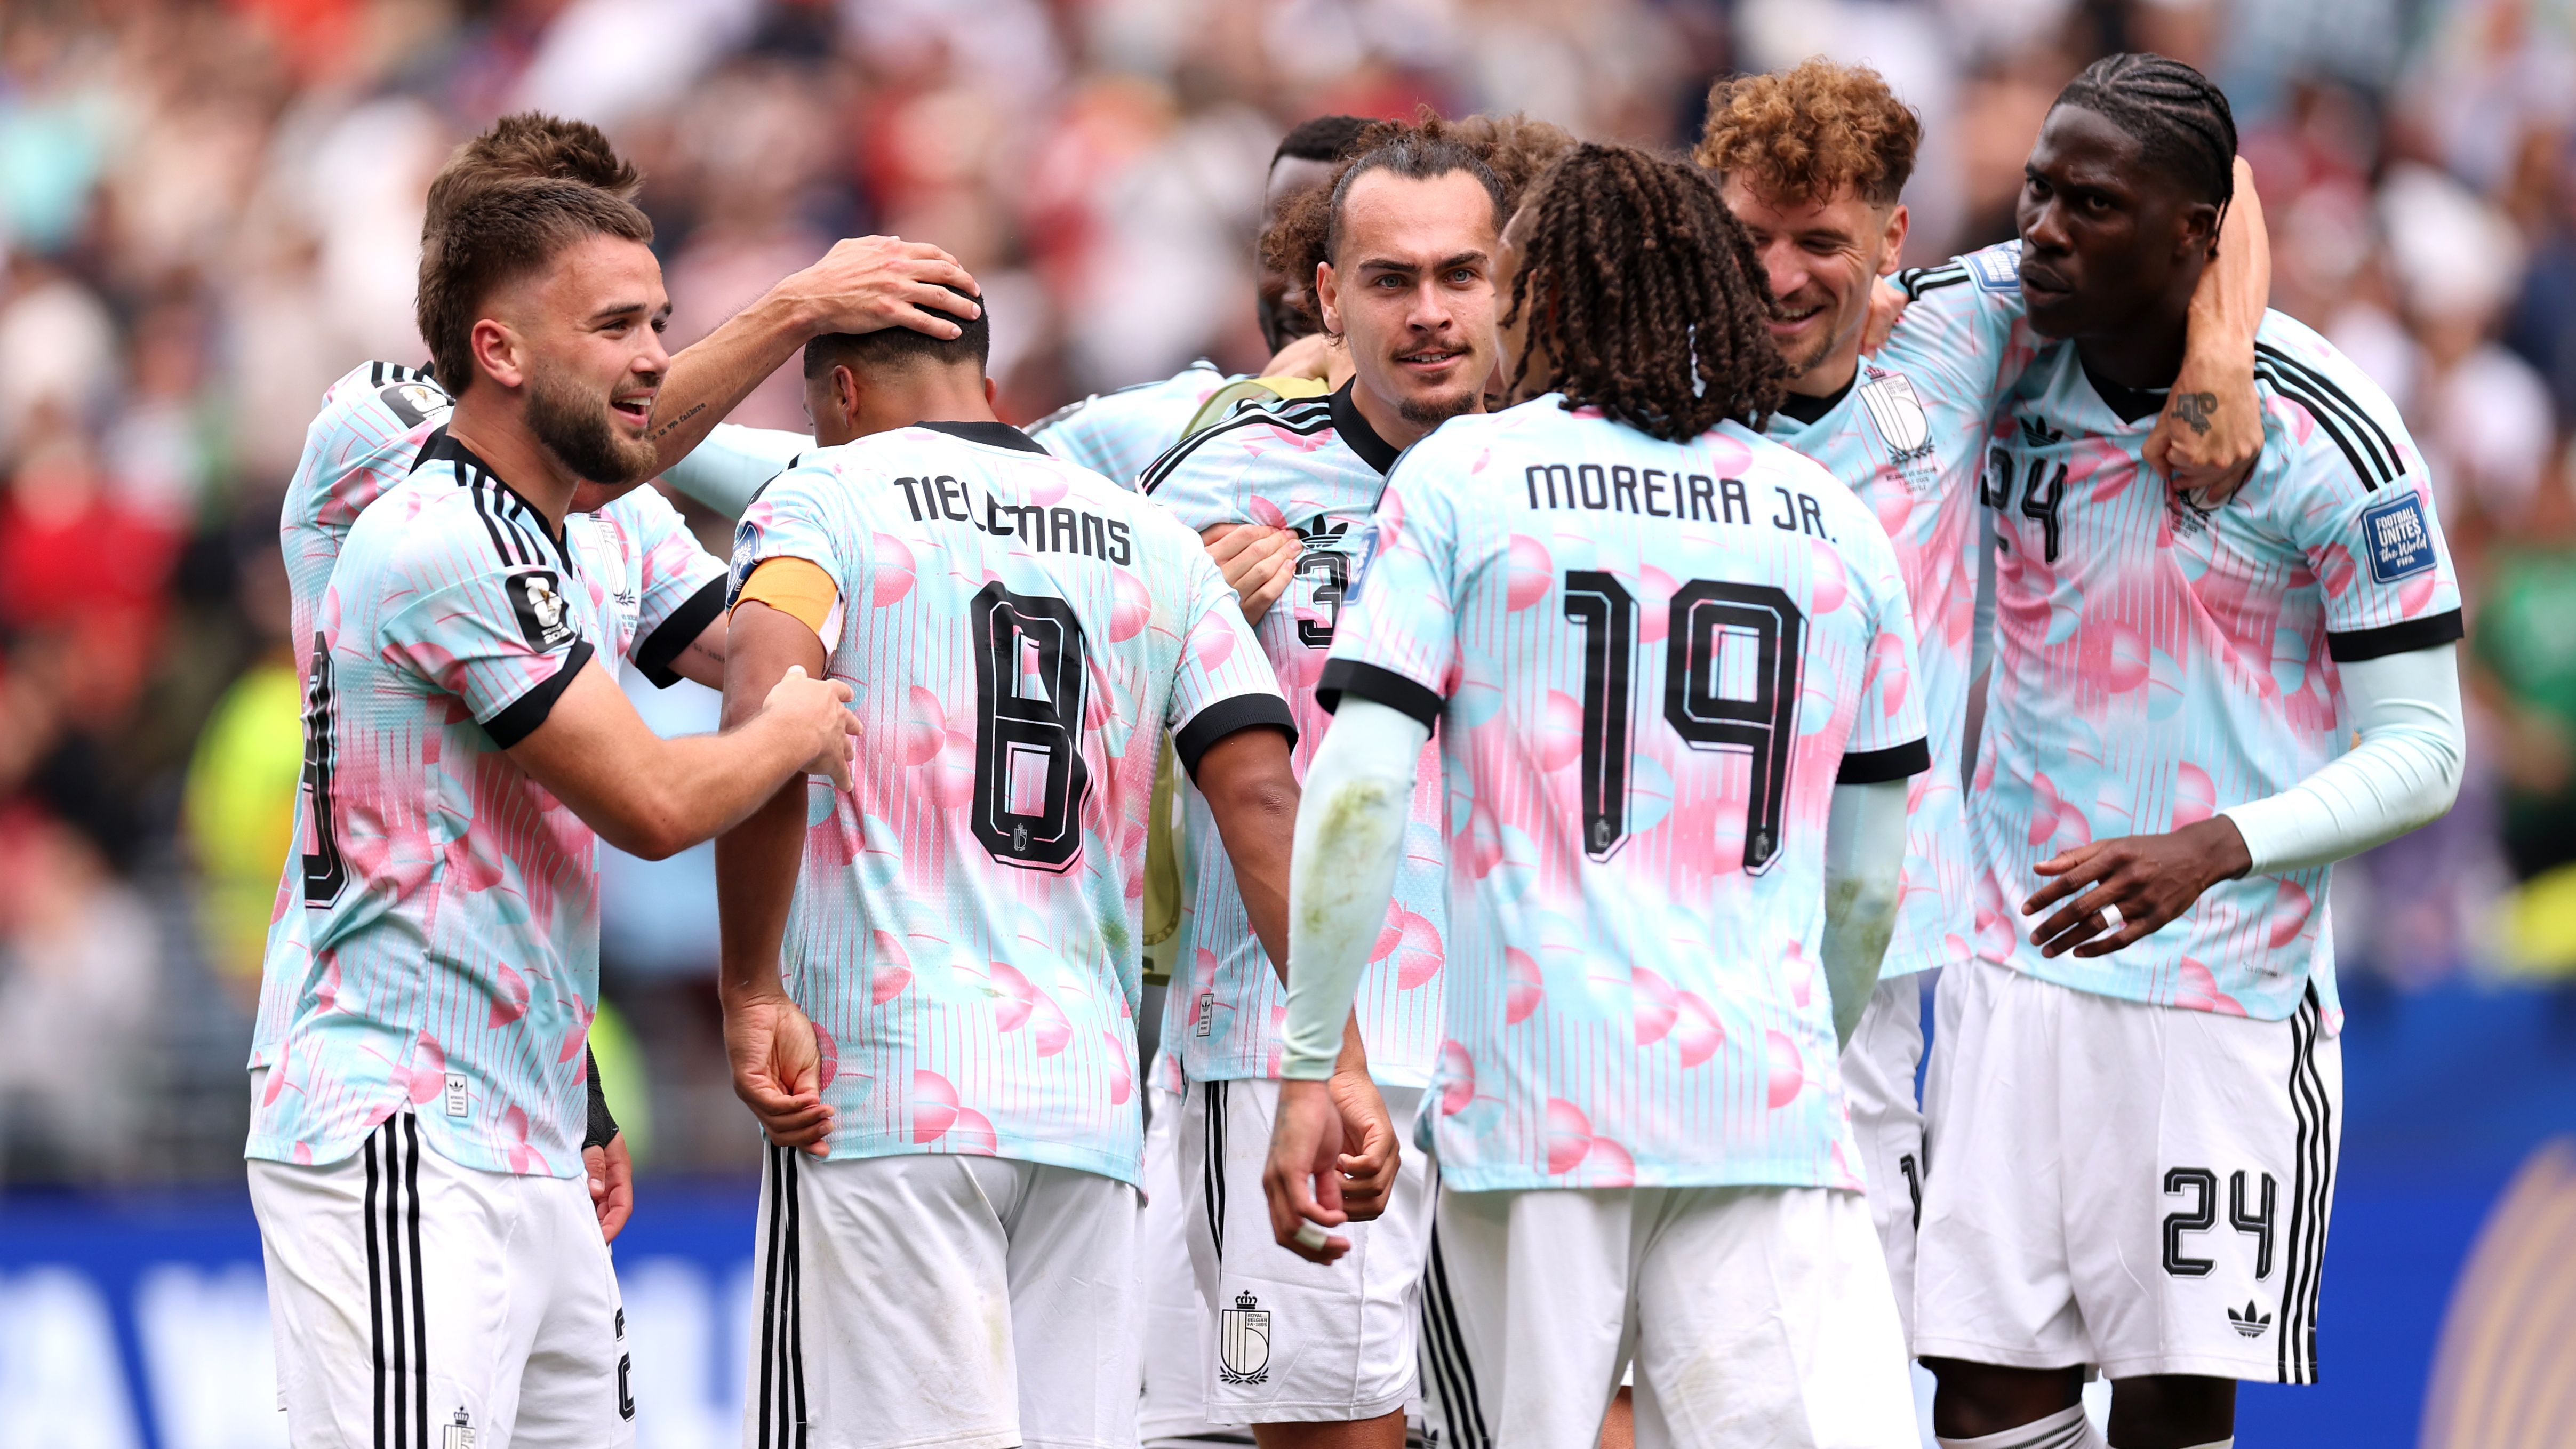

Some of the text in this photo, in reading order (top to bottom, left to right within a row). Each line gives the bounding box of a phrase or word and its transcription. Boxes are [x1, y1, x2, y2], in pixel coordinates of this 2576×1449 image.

[1526, 465, 1837, 543] MOREIRA JR.
[2375, 506, 2416, 529] FOOTBALL
[2378, 517, 2422, 547] UNITES
[2379, 533, 2427, 563] the World
[2396, 555, 2415, 568] FIFA
[543, 627, 571, 645] 202
[971, 580, 1094, 874] 8
[1564, 570, 1809, 877] 19
[2163, 1166, 2279, 1283] 24
